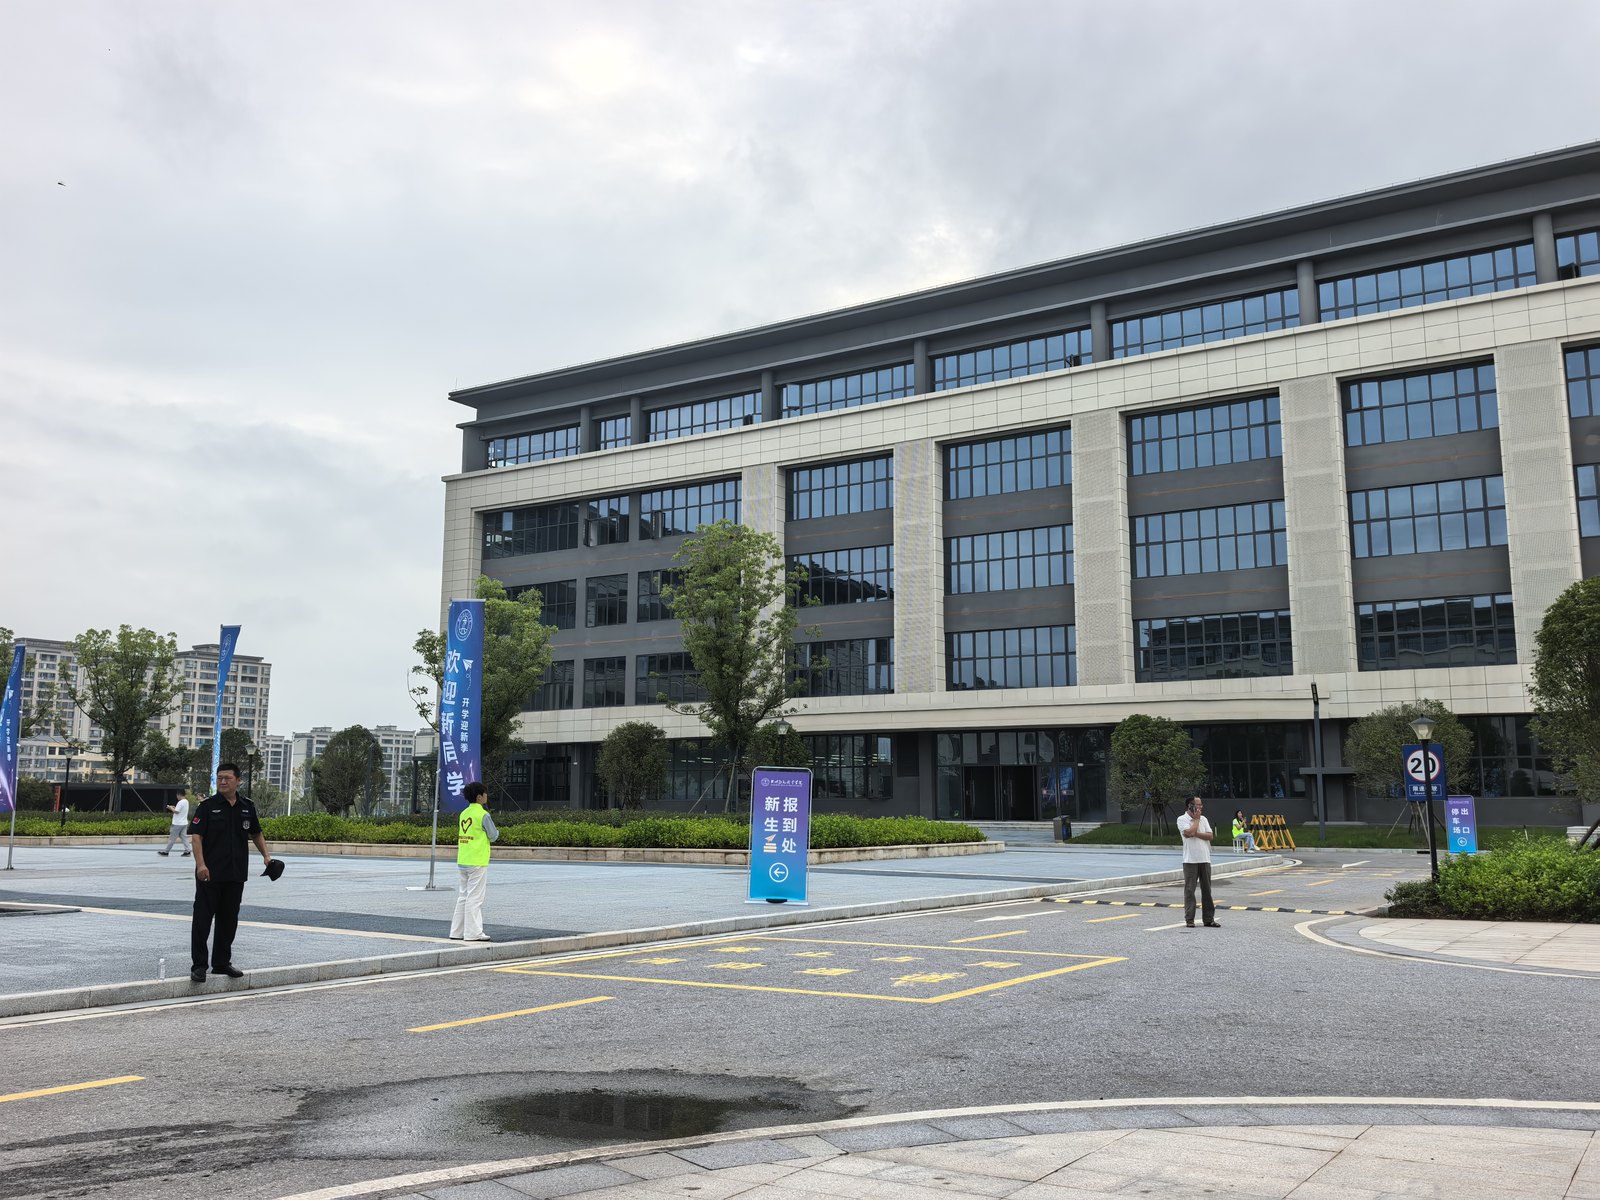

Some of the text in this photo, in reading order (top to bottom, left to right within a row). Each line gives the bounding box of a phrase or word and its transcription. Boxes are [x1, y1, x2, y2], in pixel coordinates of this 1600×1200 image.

[460, 697, 470, 753] 开学迎新季
[1410, 757, 1436, 774] 20
[764, 796, 780, 832] 新生
[781, 797, 798, 853] 报到处
[1451, 807, 1461, 834] 停车场
[1461, 808, 1470, 834] 出口
